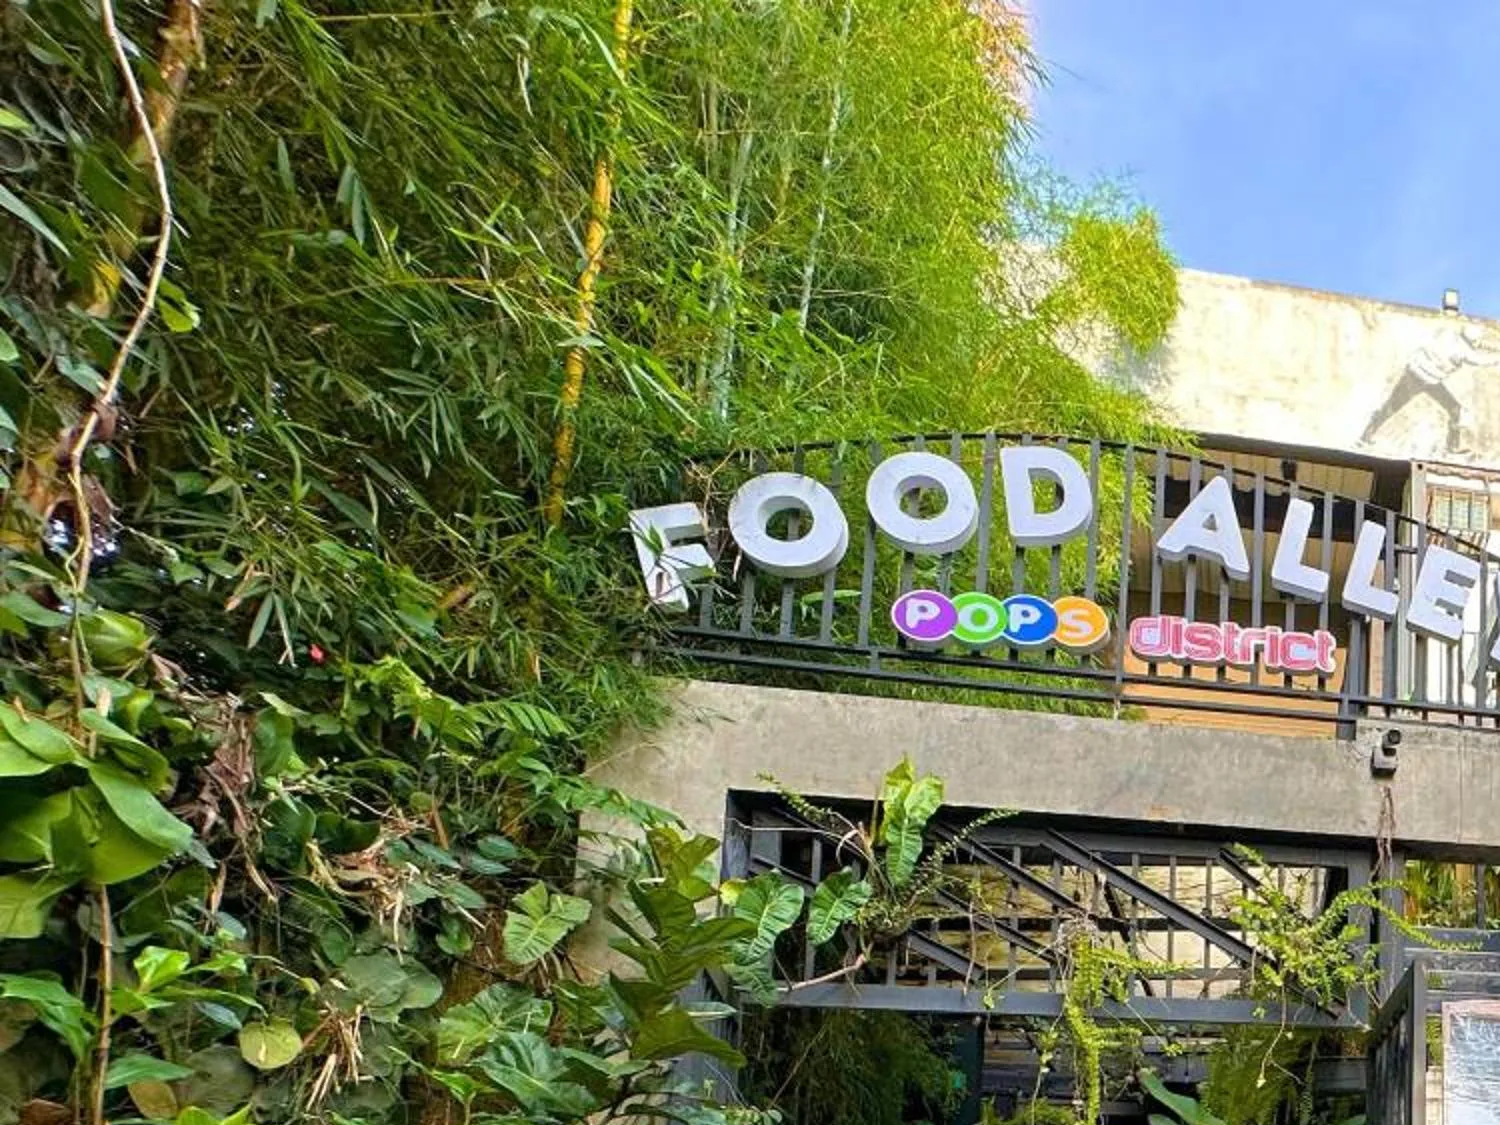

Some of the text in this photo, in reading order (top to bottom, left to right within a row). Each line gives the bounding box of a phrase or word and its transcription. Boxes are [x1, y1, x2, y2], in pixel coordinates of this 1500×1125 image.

[629, 446, 1093, 612] FOOD
[901, 596, 1336, 673] POPS district
